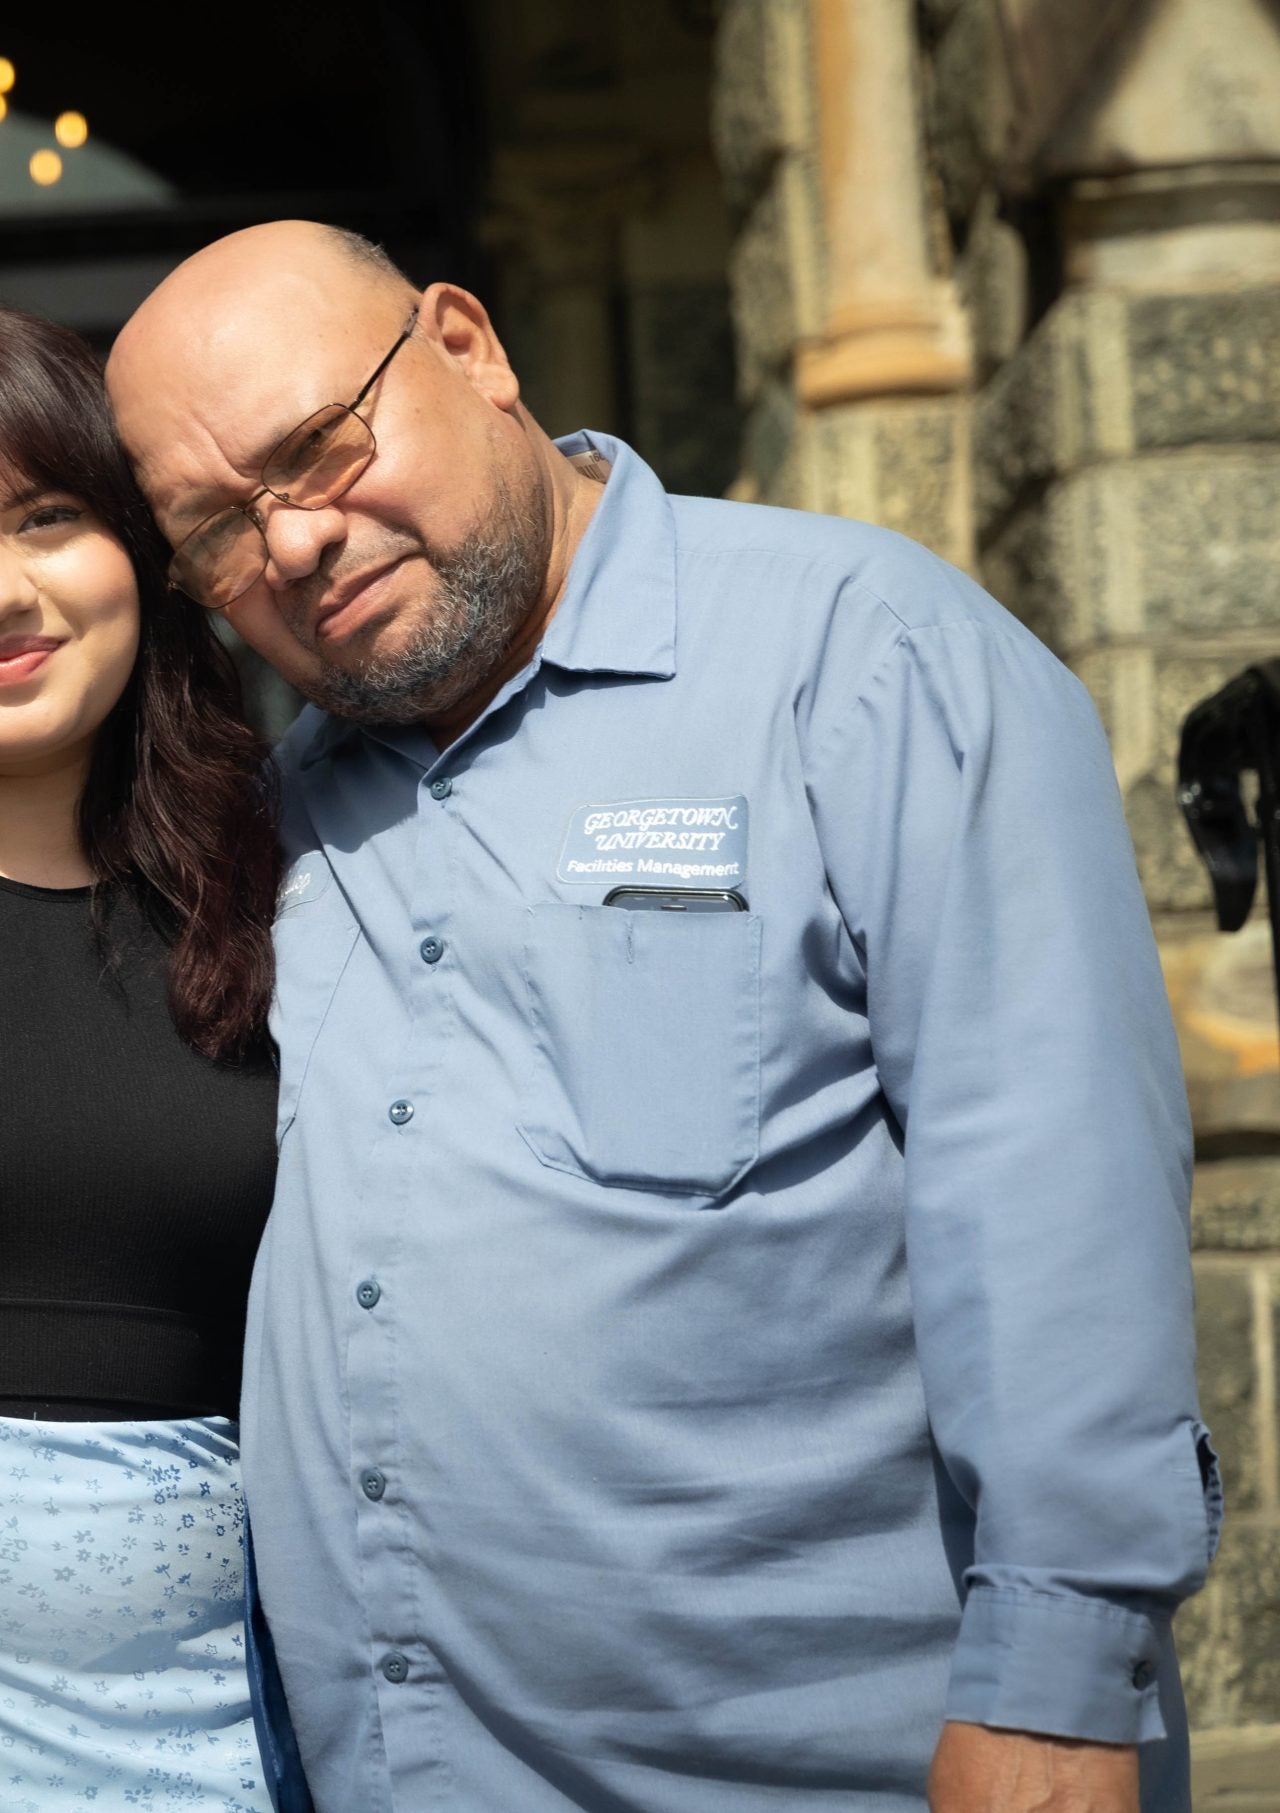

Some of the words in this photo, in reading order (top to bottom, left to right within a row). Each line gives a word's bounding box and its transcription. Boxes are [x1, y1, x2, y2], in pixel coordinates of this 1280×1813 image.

[584, 806, 739, 835] GEORGETOWN
[595, 831, 726, 851] UNIVERSITY
[567, 859, 633, 873] Facilities
[637, 858, 740, 879] Management
